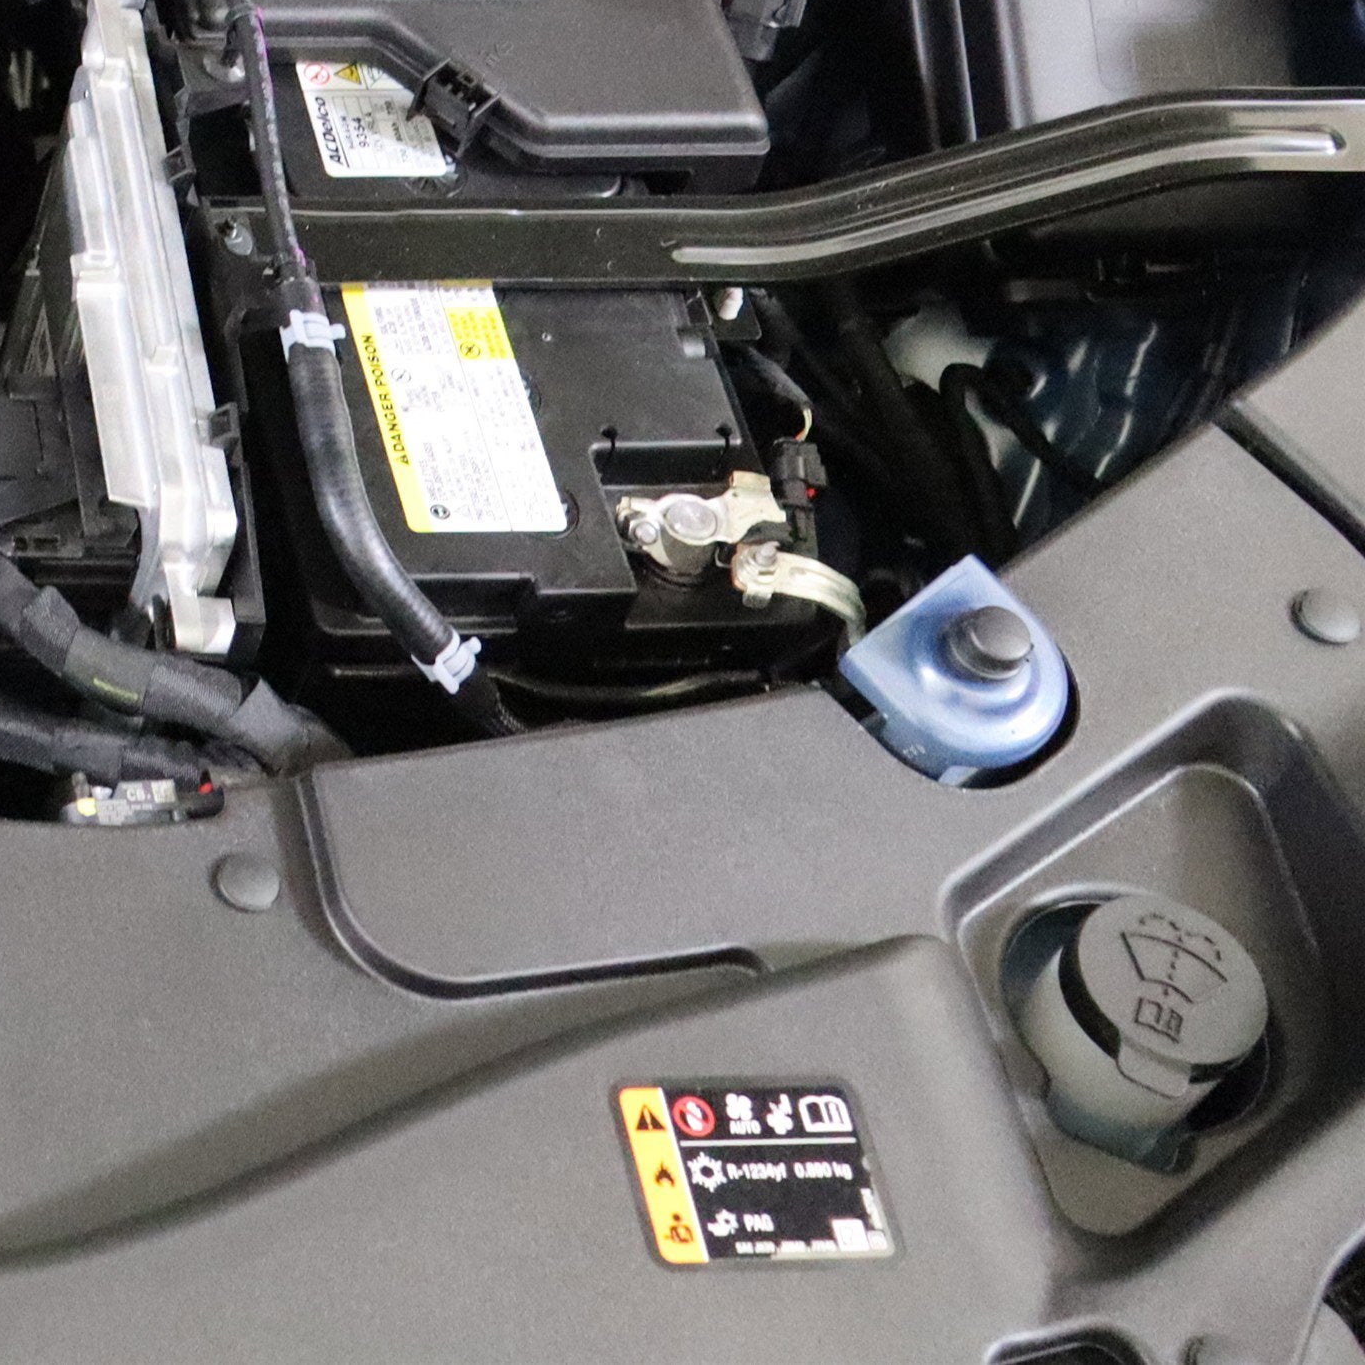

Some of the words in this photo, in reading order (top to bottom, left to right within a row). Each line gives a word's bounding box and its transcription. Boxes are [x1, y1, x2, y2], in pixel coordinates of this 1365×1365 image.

[314, 96, 343, 165] ACDelco
[362, 335, 387, 387] POISON
[378, 394, 405, 452] DANGER
[729, 1119, 762, 1135] AUTO
[726, 1162, 787, 1182] R-1234yf
[832, 1161, 853, 1180] kg
[743, 1213, 775, 1232] PAG
